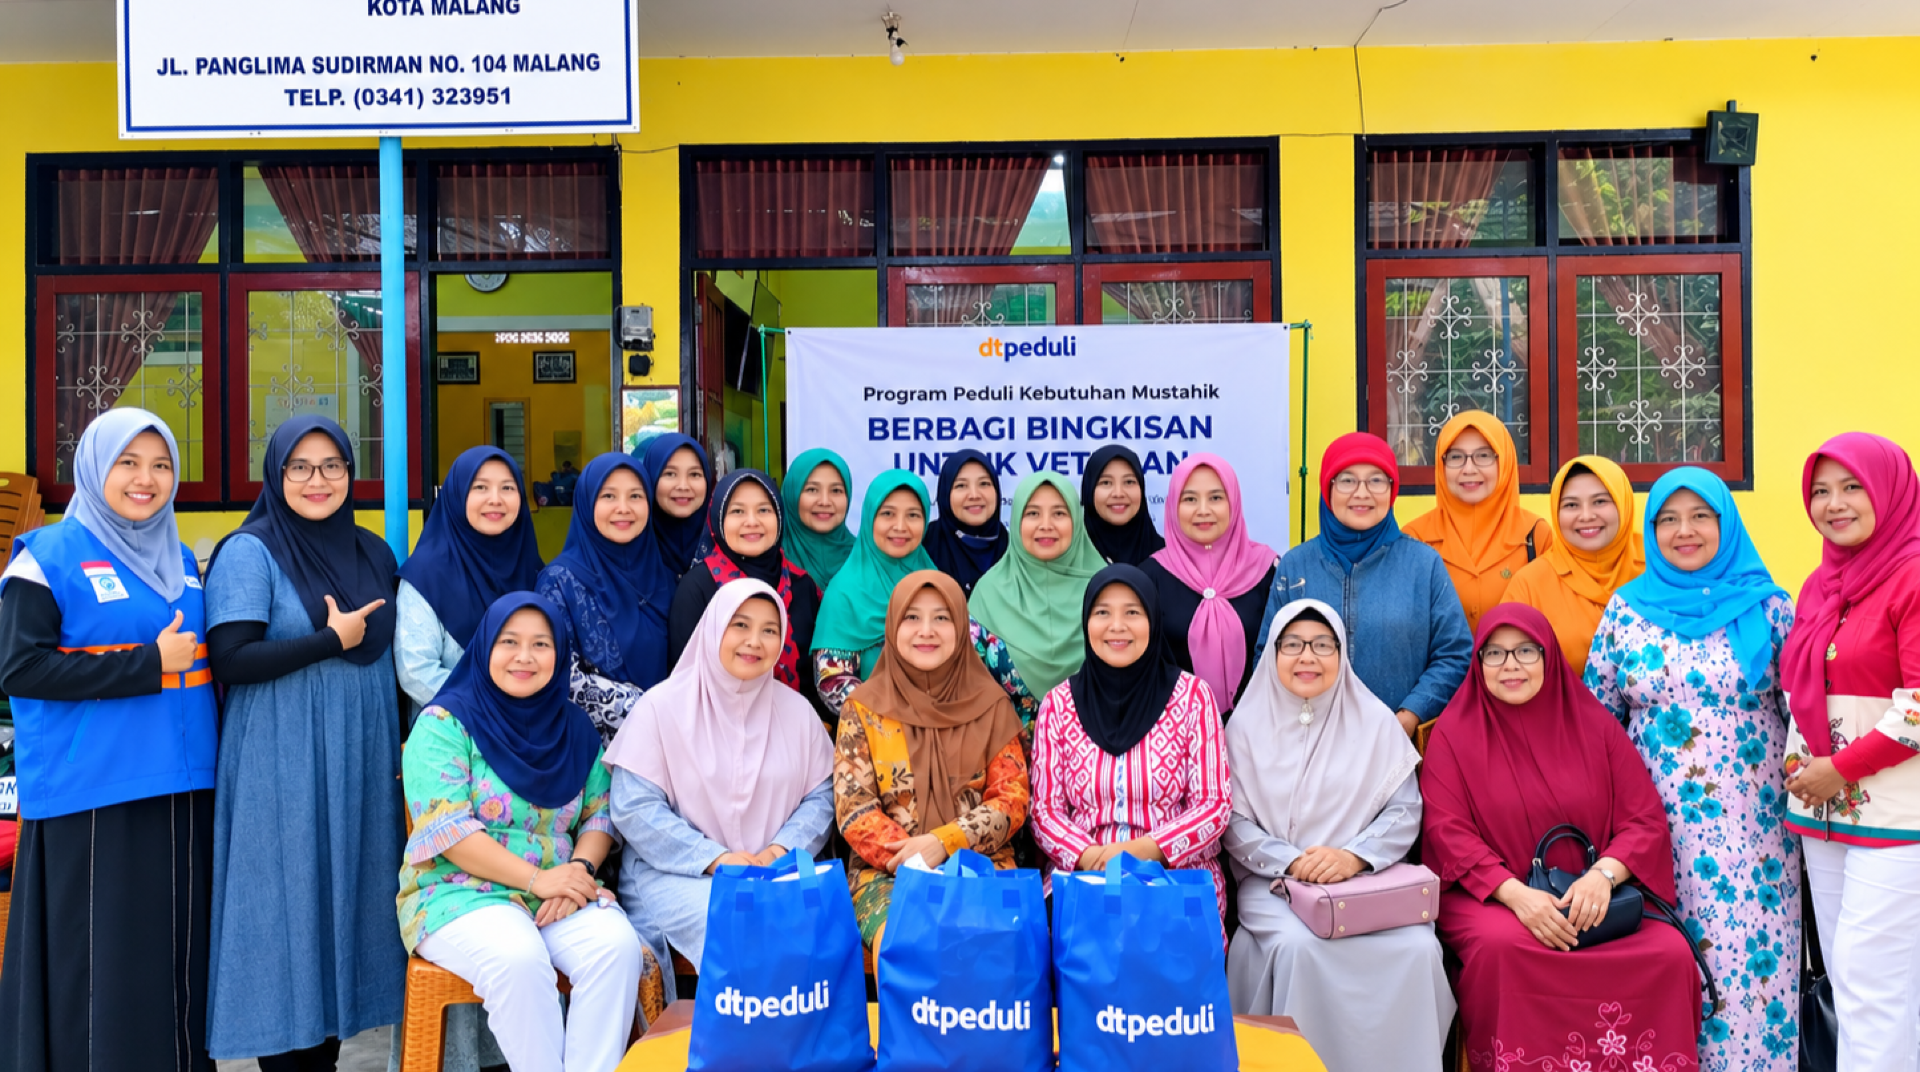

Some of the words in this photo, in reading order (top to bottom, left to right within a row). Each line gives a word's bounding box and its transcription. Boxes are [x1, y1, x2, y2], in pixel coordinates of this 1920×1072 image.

[368, 0, 424, 16] KOTA
[432, 0, 520, 16] MALANG
[157, 58, 188, 76] JL.
[196, 57, 305, 75] PANGLIMA
[313, 56, 422, 75] SUDIRMAN
[430, 55, 465, 73] NO.
[472, 54, 507, 73] 104
[514, 53, 600, 72] MALANG
[284, 89, 345, 106] TELP.
[353, 88, 424, 110] (0341)
[432, 87, 511, 106] 323951
[979, 336, 1076, 362] dtpeduli
[863, 387, 947, 405] Program
[953, 385, 1014, 401] Peduli
[1020, 384, 1126, 401] Kebutuhan
[1132, 383, 1220, 400] Mustahik
[868, 416, 1016, 442] BERBAGI
[1027, 415, 1213, 441] BINGKISAN
[894, 452, 1018, 476] UNK
[1026, 450, 1188, 476] VETAN
[715, 980, 829, 1024] dtpeduli
[912, 996, 1031, 1035] dtpeduli
[1096, 1003, 1215, 1043] dtpeduli
